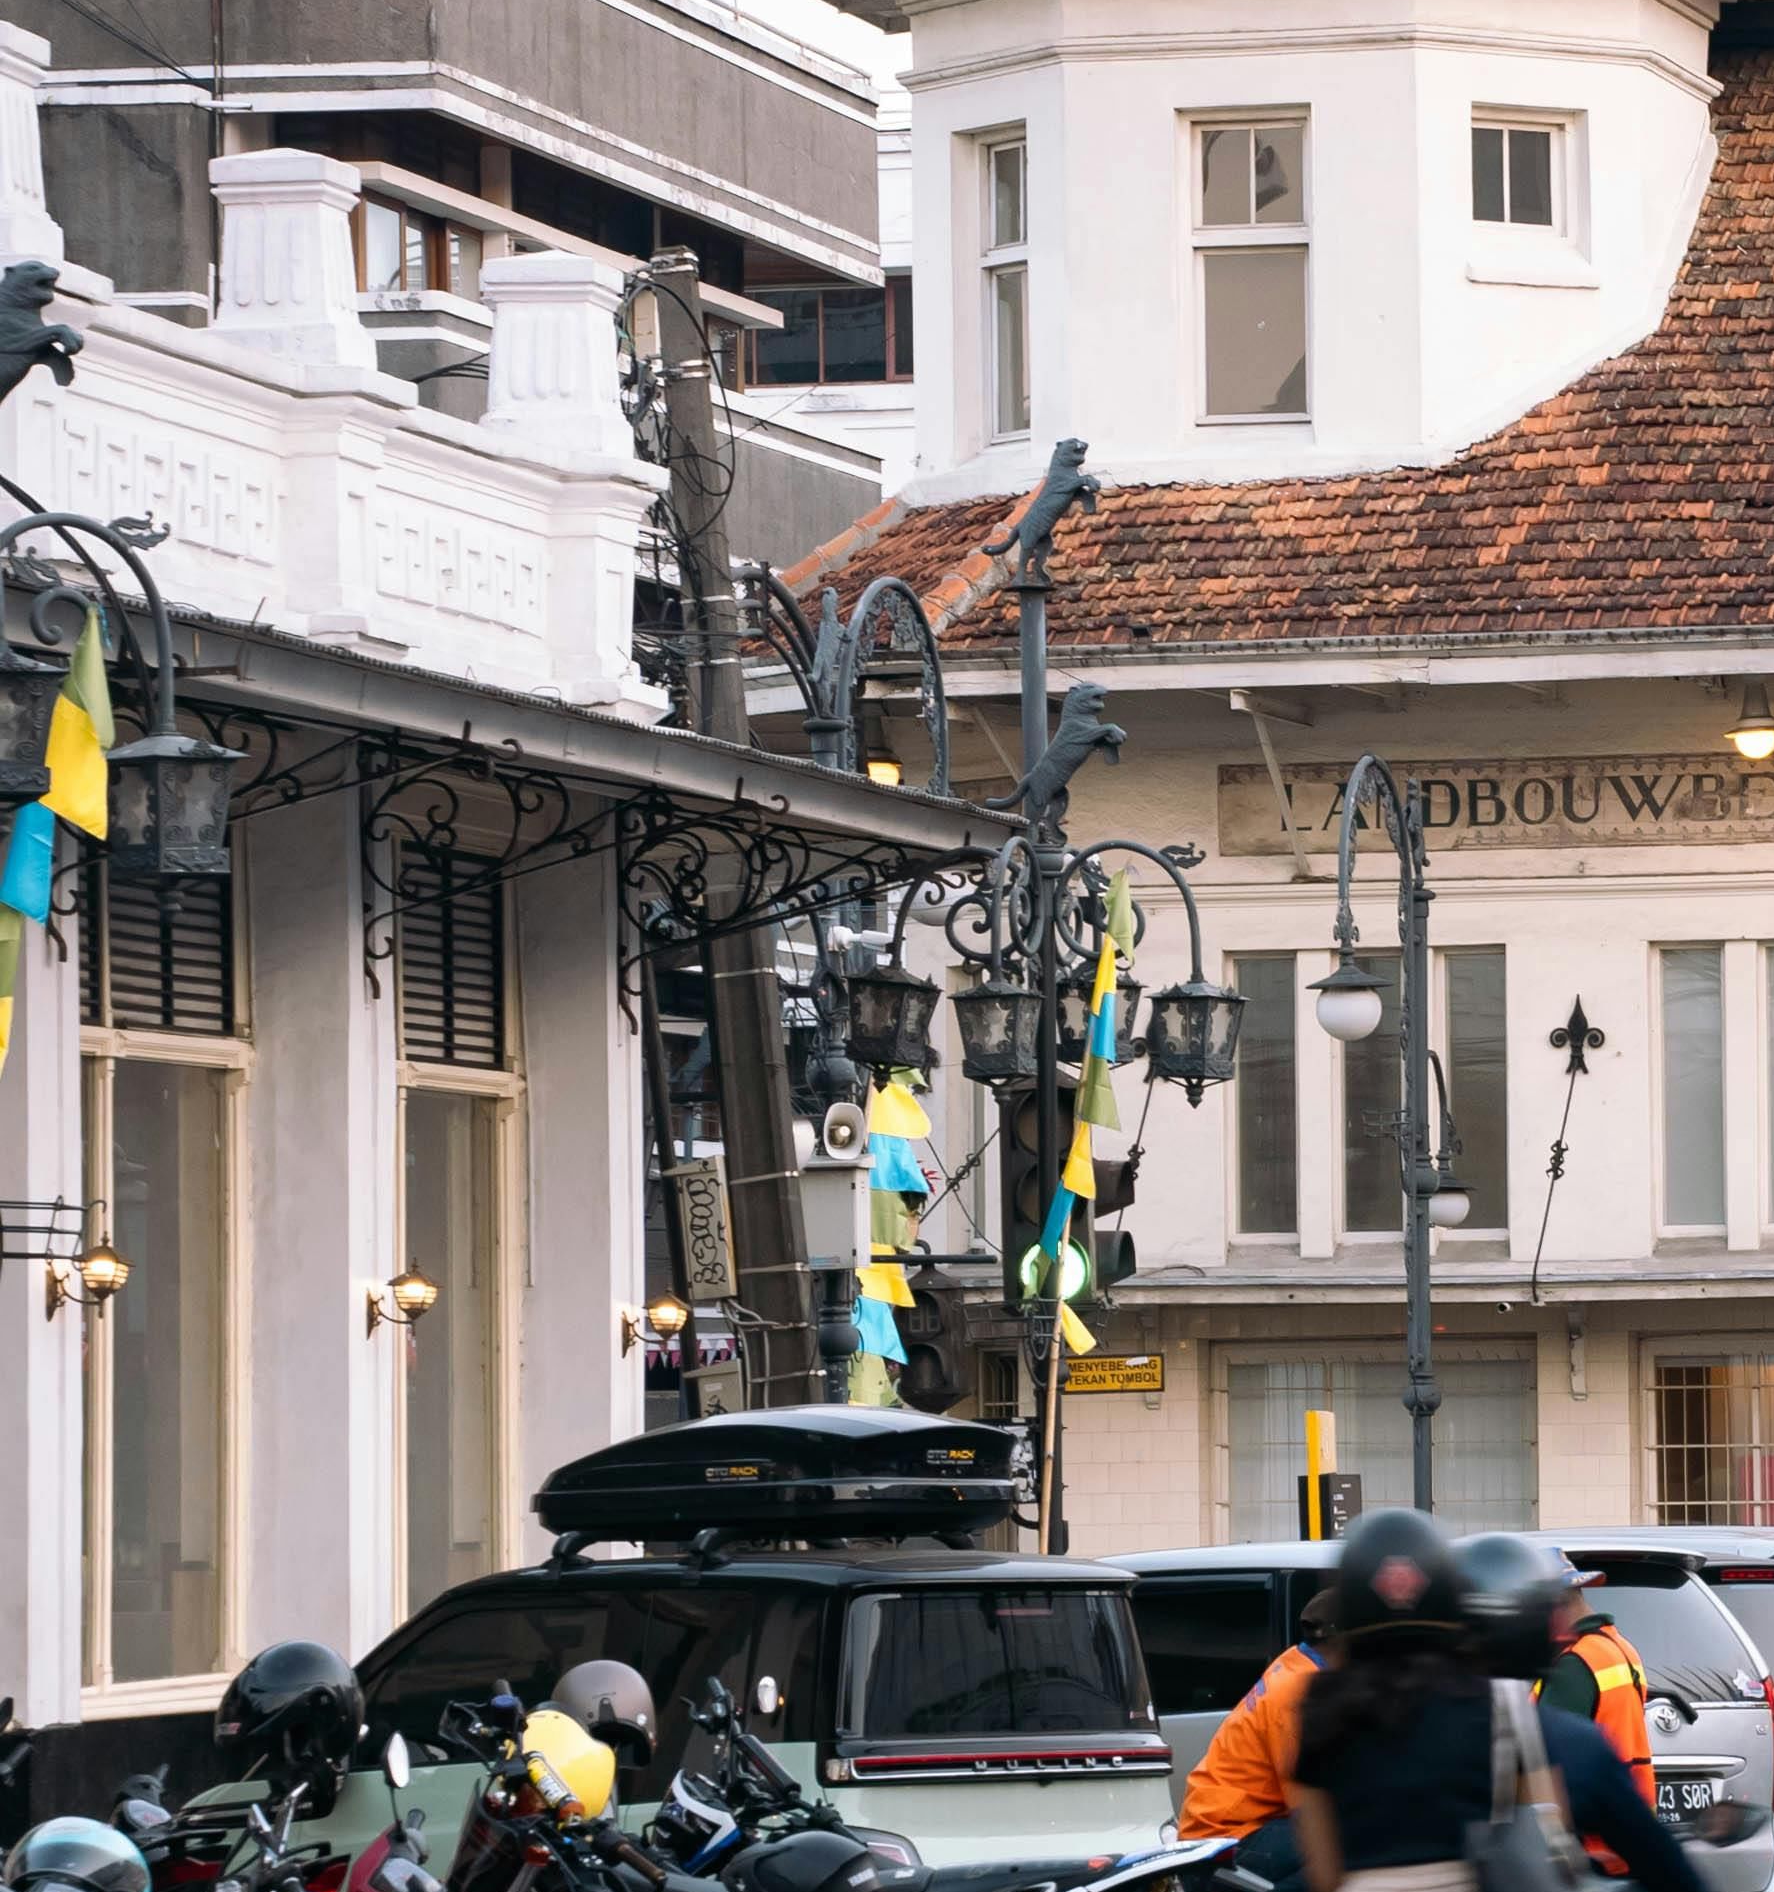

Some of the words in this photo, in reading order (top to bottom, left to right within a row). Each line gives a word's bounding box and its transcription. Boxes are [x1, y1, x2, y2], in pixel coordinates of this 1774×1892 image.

[1069, 1374, 1106, 1386] TEKAN
[1110, 1371, 1159, 1384] TOMBOL
[975, 1755, 1123, 1771] WULING
